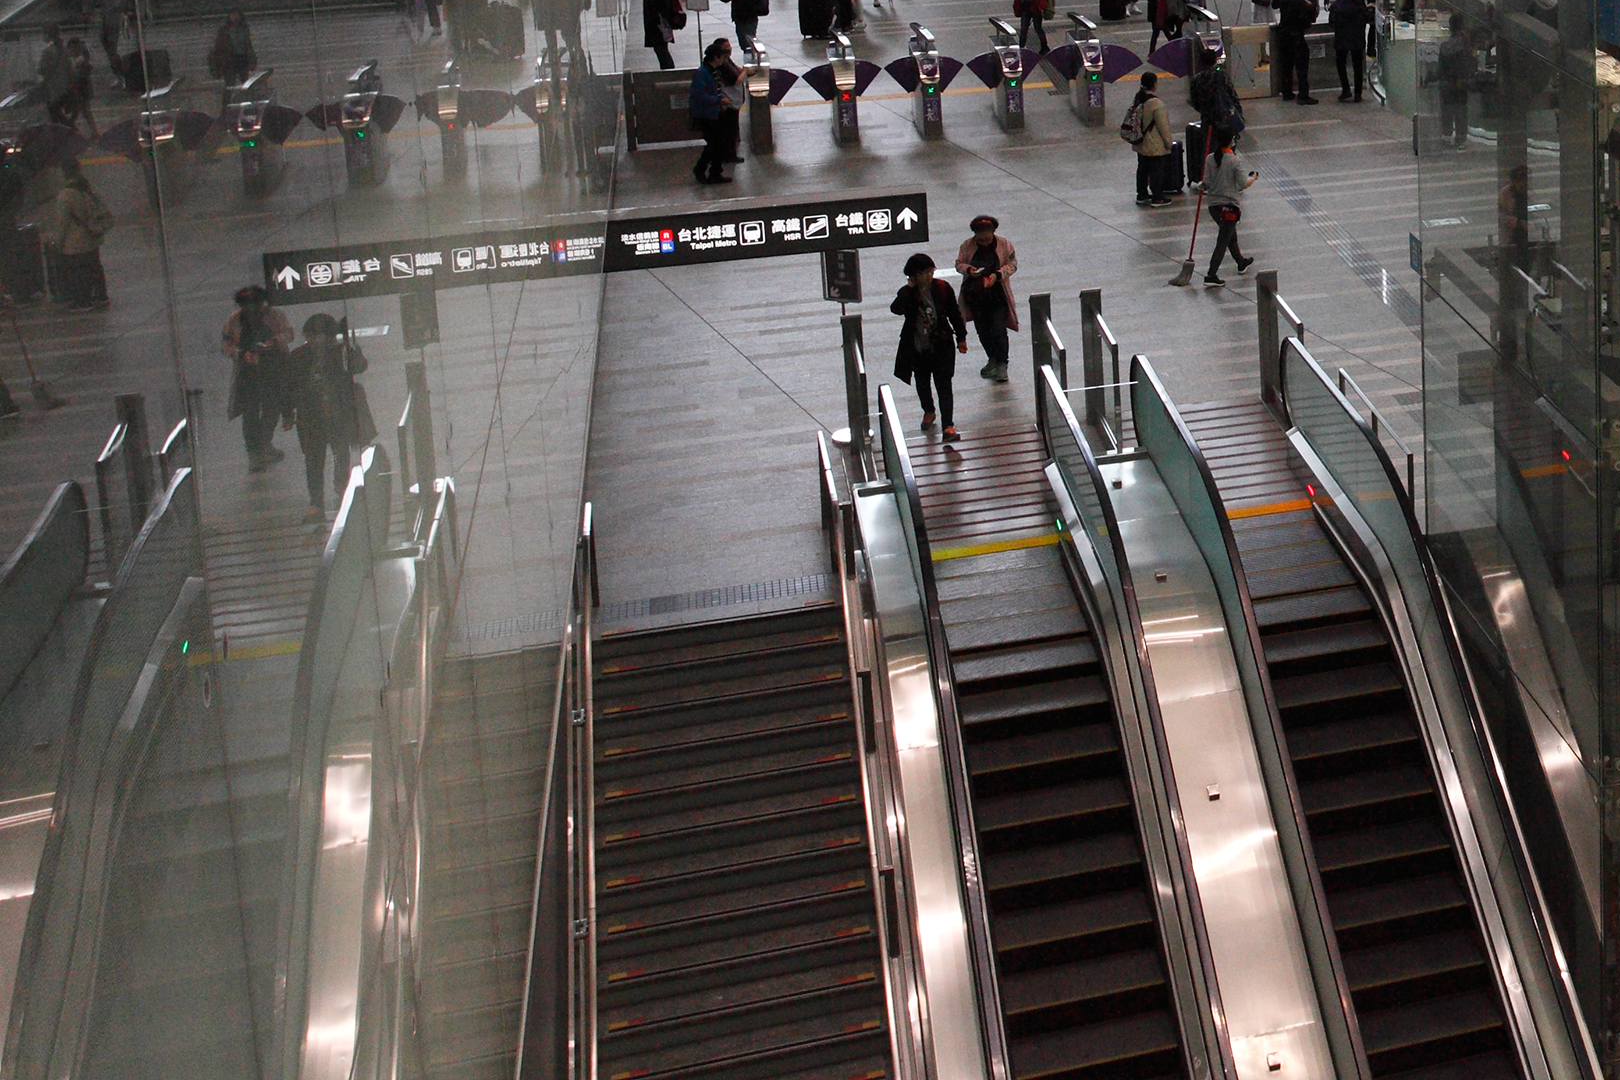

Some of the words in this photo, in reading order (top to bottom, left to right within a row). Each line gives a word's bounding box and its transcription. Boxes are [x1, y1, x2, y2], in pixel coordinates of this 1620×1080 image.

[678, 224, 737, 242] 台北捷運
[771, 218, 801, 233] 高鐵
[835, 212, 864, 228] 台鐵
[690, 240, 714, 251] Taipei
[715, 240, 738, 248] Metro
[784, 233, 802, 241] HSR
[848, 227, 865, 235] TRA
